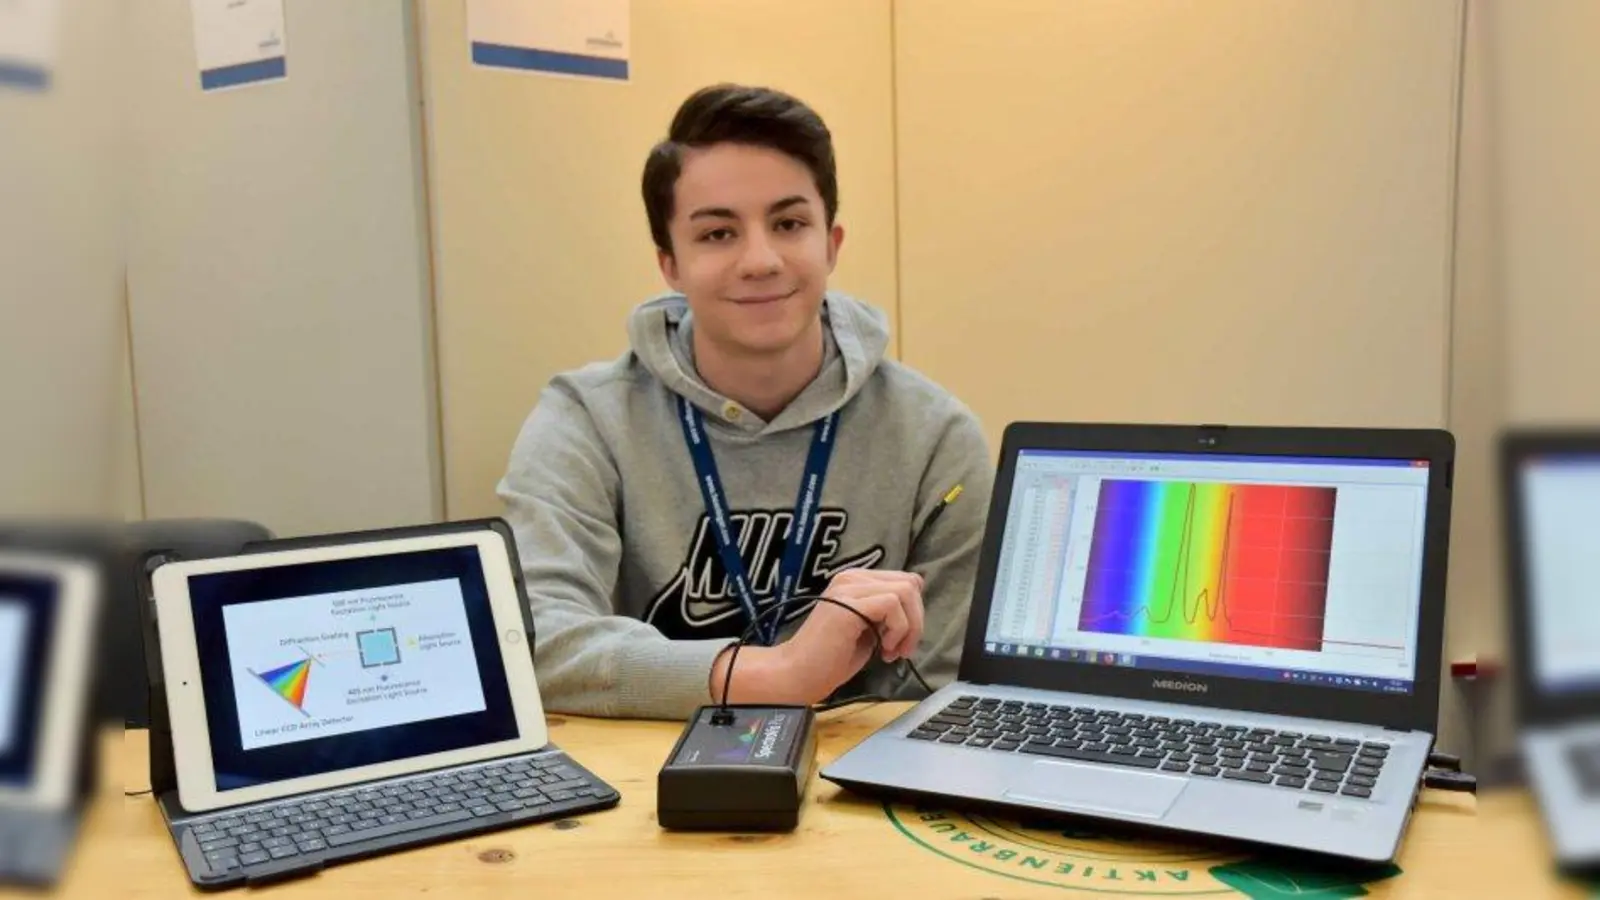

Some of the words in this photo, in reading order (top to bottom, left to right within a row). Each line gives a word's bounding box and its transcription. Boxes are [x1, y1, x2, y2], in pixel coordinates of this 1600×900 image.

[687, 510, 848, 600] NIKE
[279, 635, 320, 647] Diffraction
[1152, 677, 1208, 692] MEDION
[254, 726, 280, 737] Linear
[300, 720, 321, 729] Array
[321, 716, 355, 727] Detector
